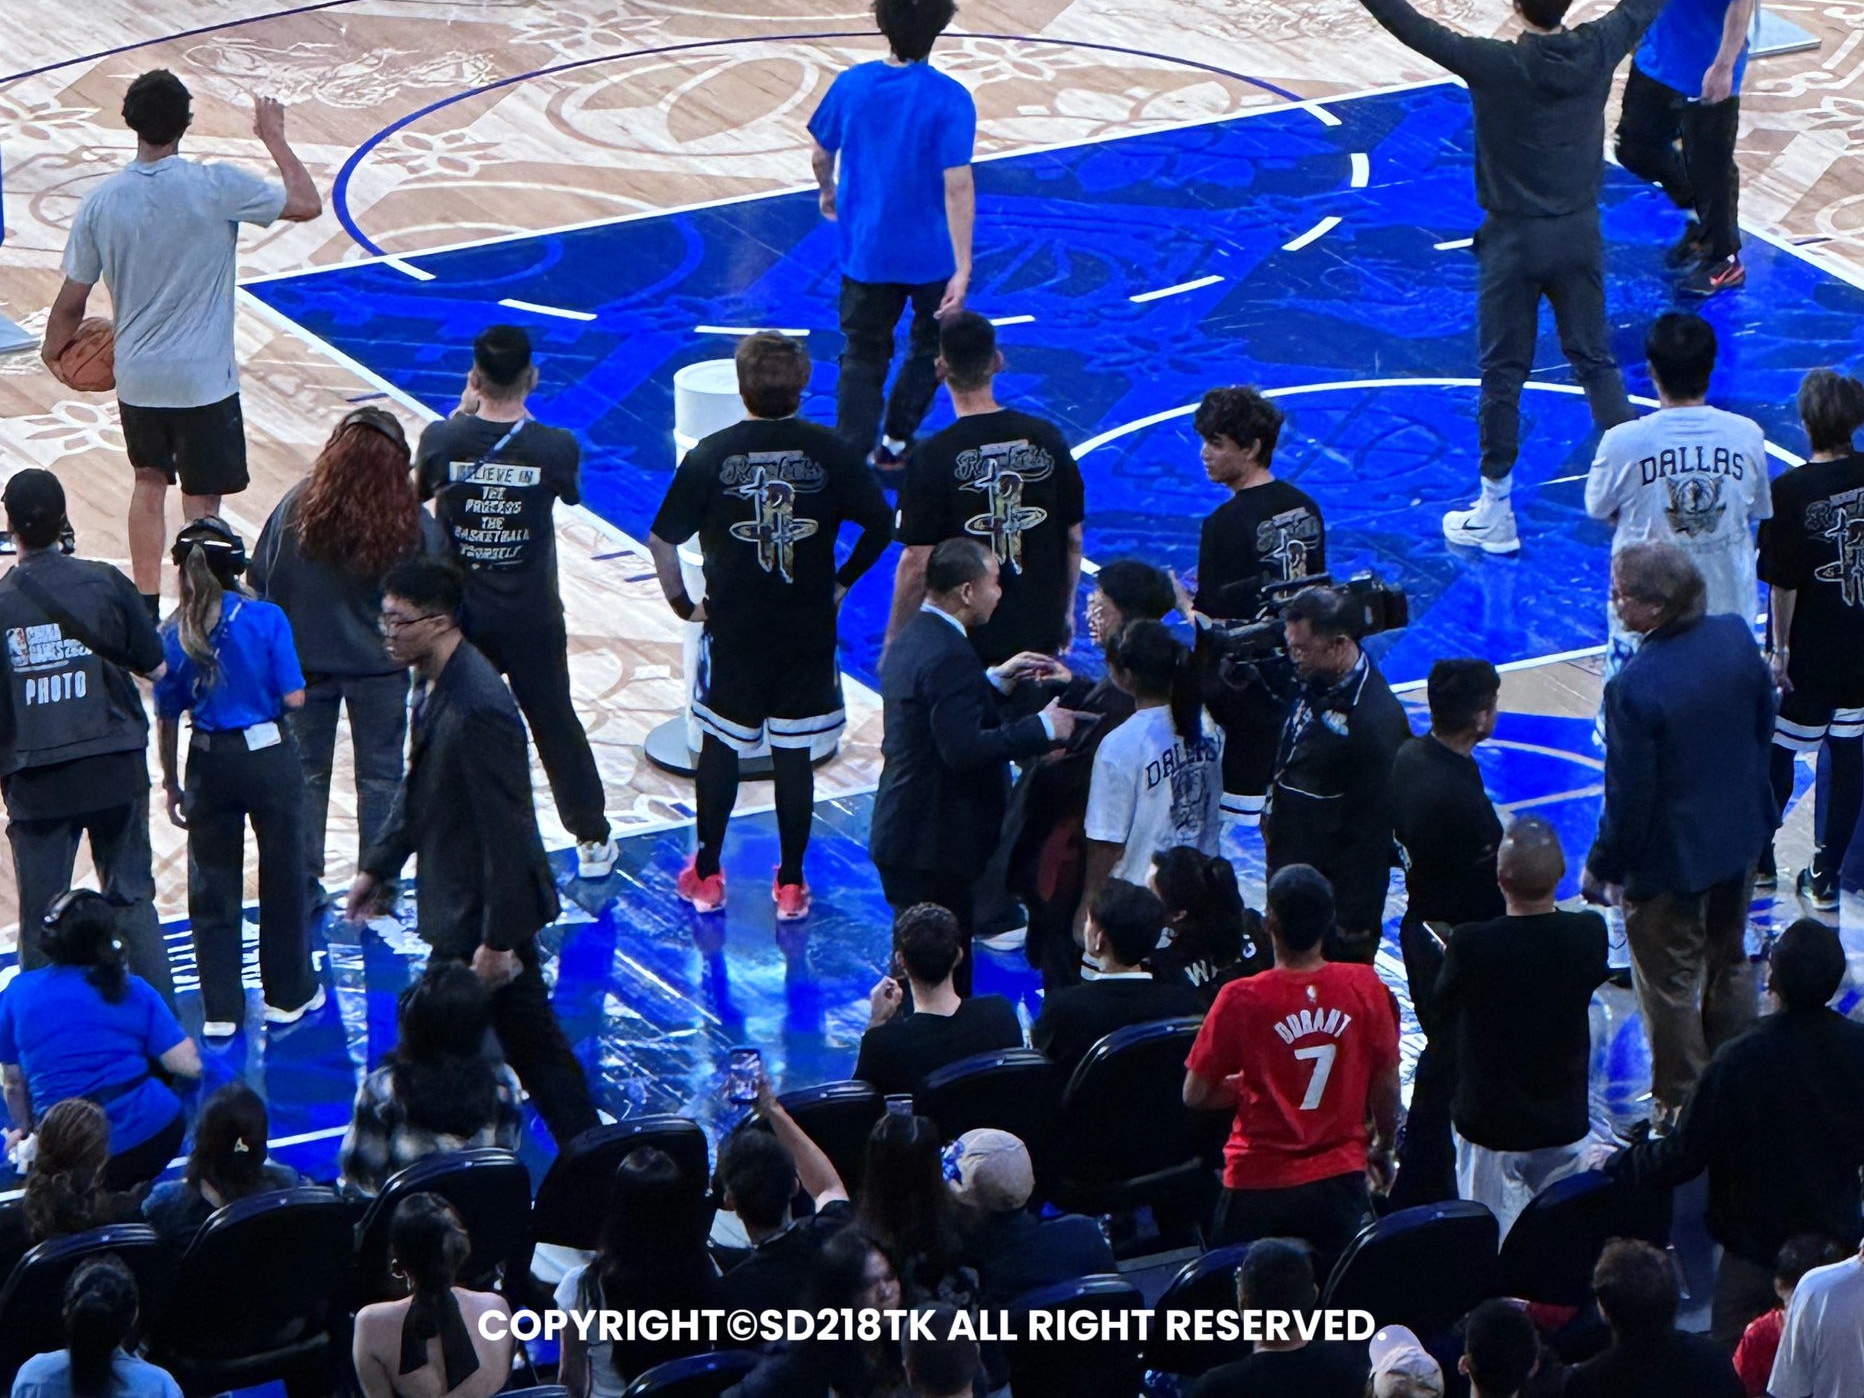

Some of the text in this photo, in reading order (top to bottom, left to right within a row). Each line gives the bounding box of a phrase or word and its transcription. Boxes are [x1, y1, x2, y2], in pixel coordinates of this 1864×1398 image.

[456, 465, 514, 483] LIEVE
[1639, 445, 1744, 486] DALLAS
[25, 670, 87, 706] PHOTO
[1273, 1007, 1352, 1045] DURANT
[1293, 1043, 1337, 1110] 7
